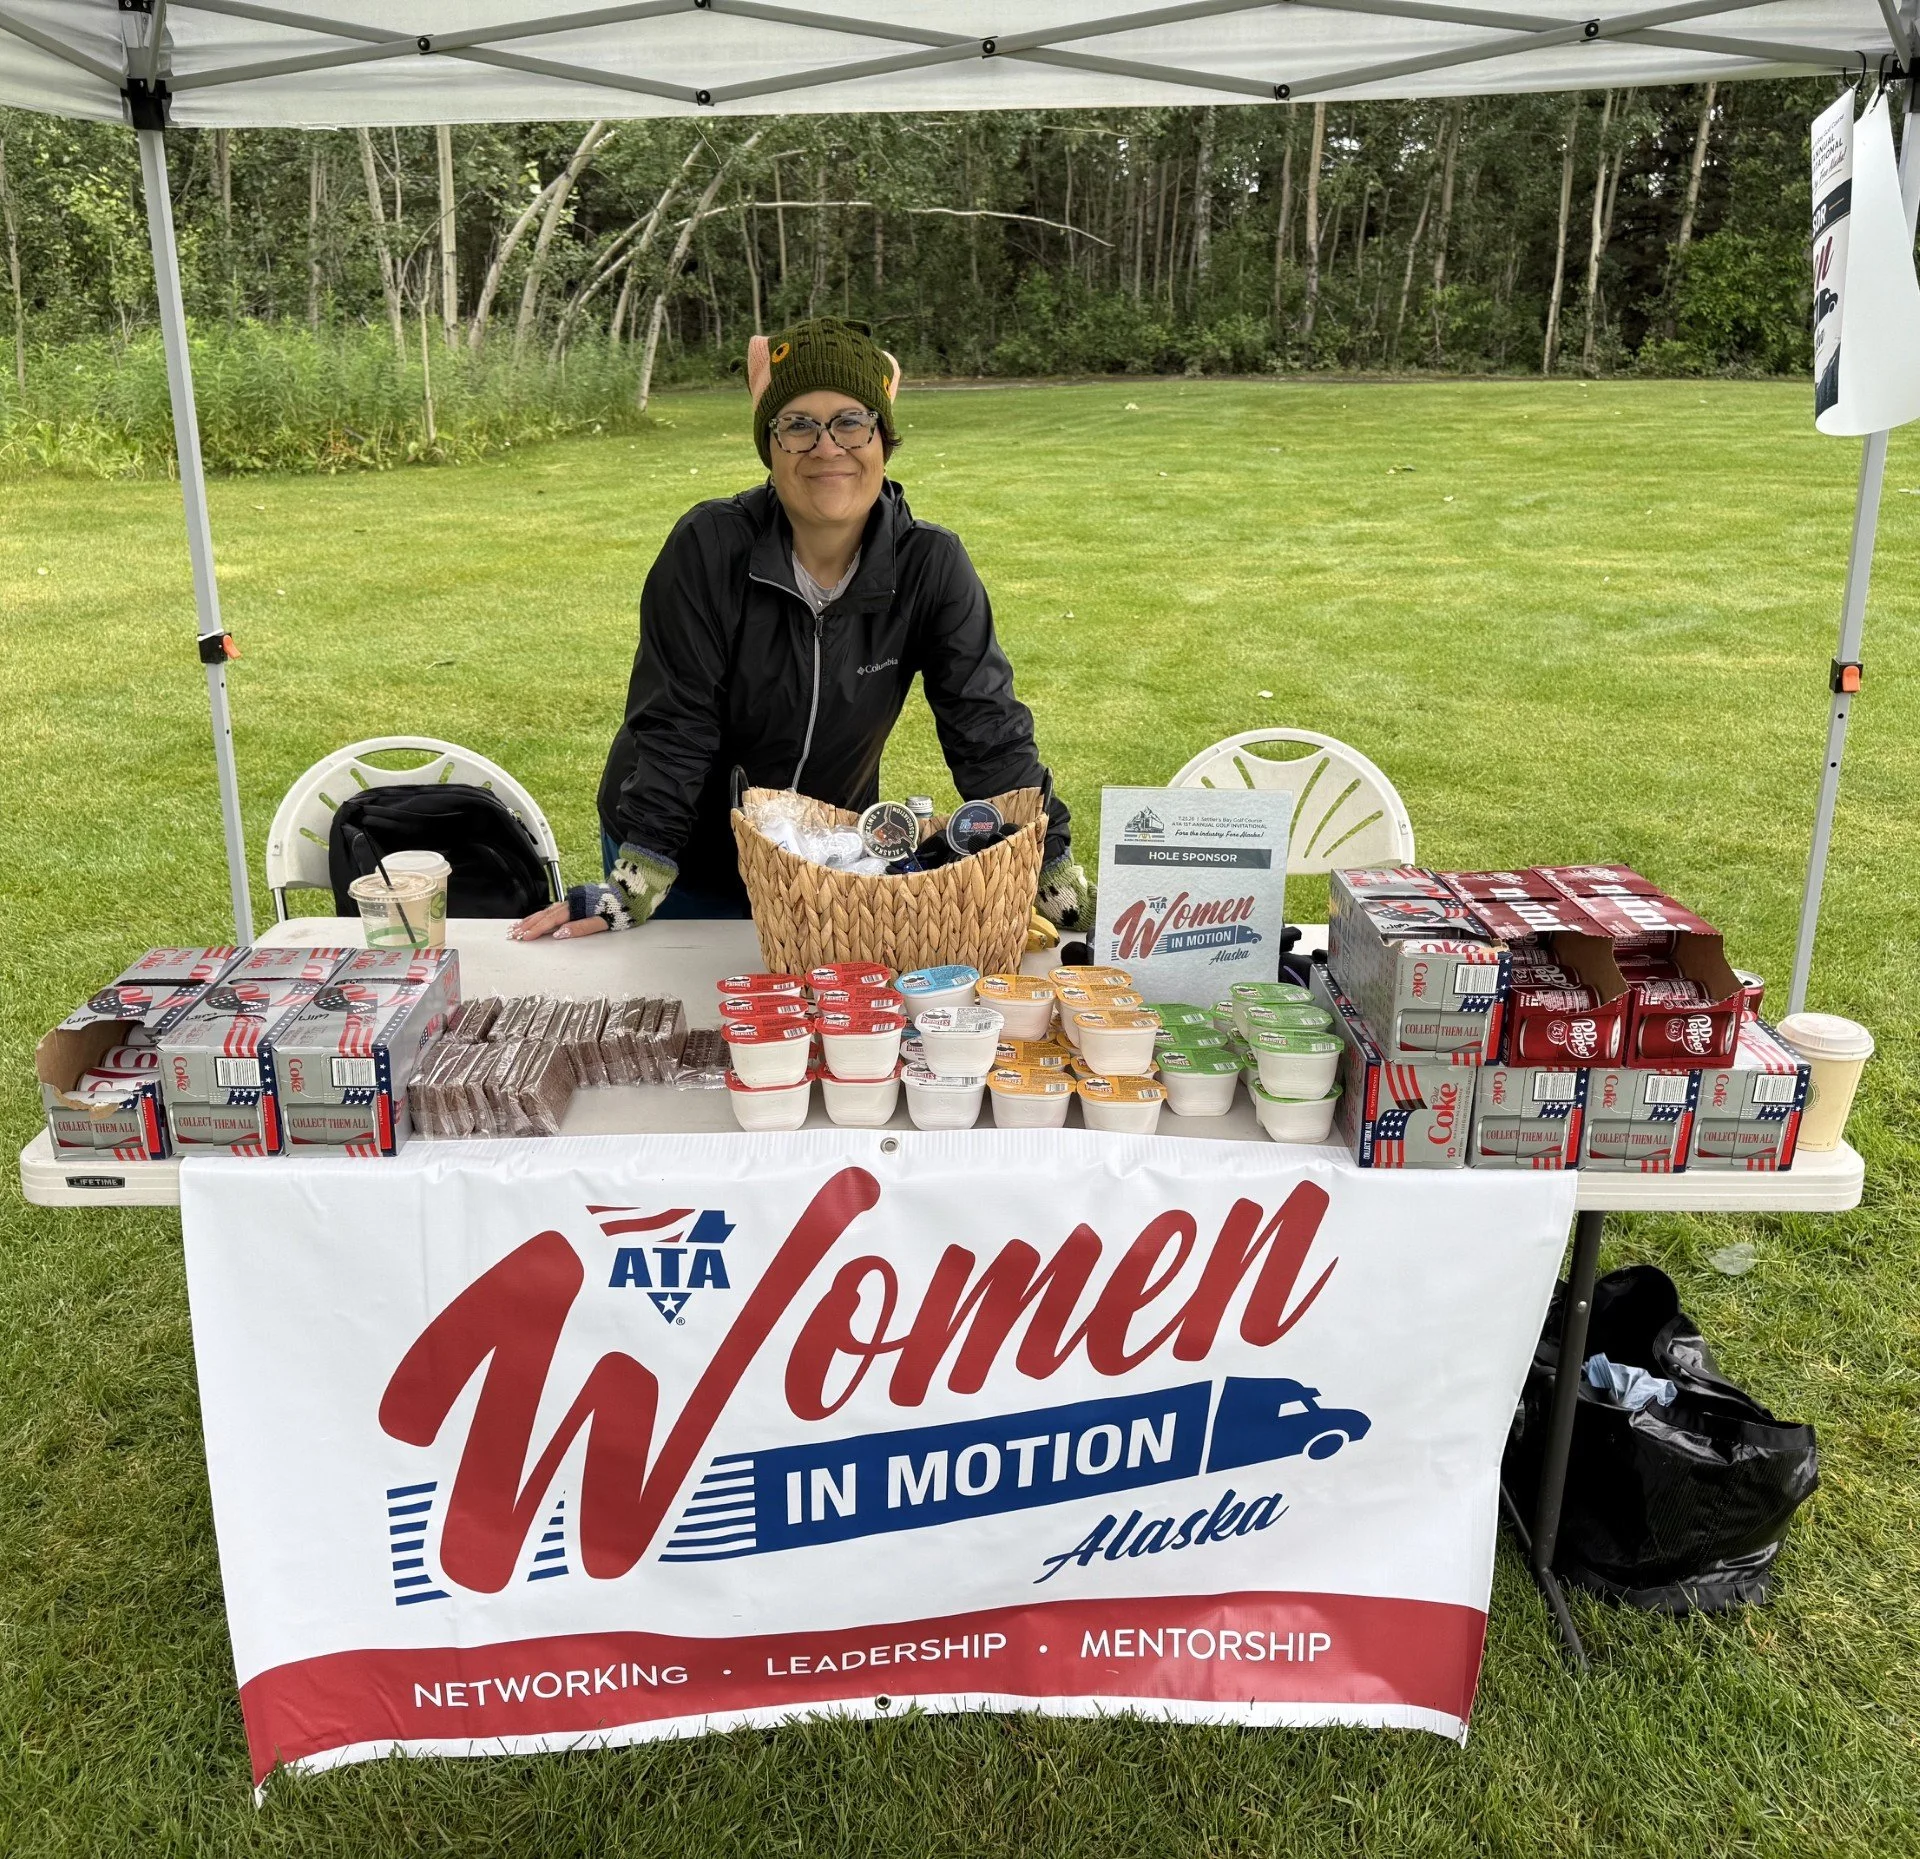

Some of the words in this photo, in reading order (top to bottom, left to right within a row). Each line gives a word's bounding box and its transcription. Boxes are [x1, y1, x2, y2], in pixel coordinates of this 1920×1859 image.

[865, 657, 899, 674] Columbia
[874, 844, 900, 857] ALASKA
[1149, 851, 1180, 861] HOLE
[1182, 852, 1238, 863] SPONSOR
[1149, 901, 1167, 909] ATA
[1112, 891, 1255, 960] Women
[1171, 937, 1184, 949] IN
[1186, 930, 1232, 947] MOTION
[1208, 948, 1251, 966] Alaska
[1412, 962, 1428, 998] Coke
[920, 1017, 951, 1027] PRINGLES
[1405, 1024, 1439, 1035] COLLECT
[1441, 1026, 1462, 1037] THEM
[1463, 1026, 1479, 1037] ALL
[1551, 1025, 1564, 1036] 23
[1670, 1024, 1680, 1033] 23
[1569, 1019, 1596, 1056] Pepper
[1584, 1031, 1597, 1048] Dr
[1685, 1014, 1711, 1053] Pepper
[1699, 1027, 1713, 1044] Dr
[173, 1056, 189, 1091] Coke
[289, 1058, 304, 1092] Coke
[906, 1069, 937, 1081] PRINGLES
[1493, 1071, 1507, 1105] Coke
[1603, 1074, 1618, 1108] Coke
[1712, 1074, 1730, 1107] Coke
[1428, 1083, 1458, 1144] Coke
[58, 1121, 92, 1133] COLLECT
[94, 1123, 118, 1133] THEM
[119, 1123, 135, 1133] ALL
[179, 1117, 211, 1127] COLLECT
[213, 1119, 236, 1129] THEM
[236, 1119, 254, 1129] ALL
[293, 1118, 326, 1128] COLLECT
[328, 1119, 352, 1129] THEM
[352, 1119, 368, 1129] ALL
[1486, 1130, 1519, 1140] COLLECT
[1521, 1131, 1543, 1142] THEM
[1543, 1132, 1558, 1142] ALL
[1595, 1133, 1629, 1143] COLLECT
[1631, 1134, 1652, 1144] THEM
[1652, 1135, 1668, 1144] ALL
[1703, 1131, 1736, 1142] COLLECT
[1738, 1133, 1759, 1144] THEM
[1759, 1133, 1774, 1144] ALL
[1447, 1147, 1456, 1158] 10
[73, 1177, 119, 1186] LIFETIME
[608, 1247, 731, 1289] ATA
[379, 1167, 1332, 1594] Women
[786, 1462, 857, 1525] IN
[887, 1411, 1178, 1509] MOTION
[1035, 1489, 1288, 1584] Alaska
[414, 1663, 689, 1708] NETWORKING
[766, 1632, 1008, 1676] LEADERSHIP
[1080, 1625, 1333, 1665] MENTORSHIP
